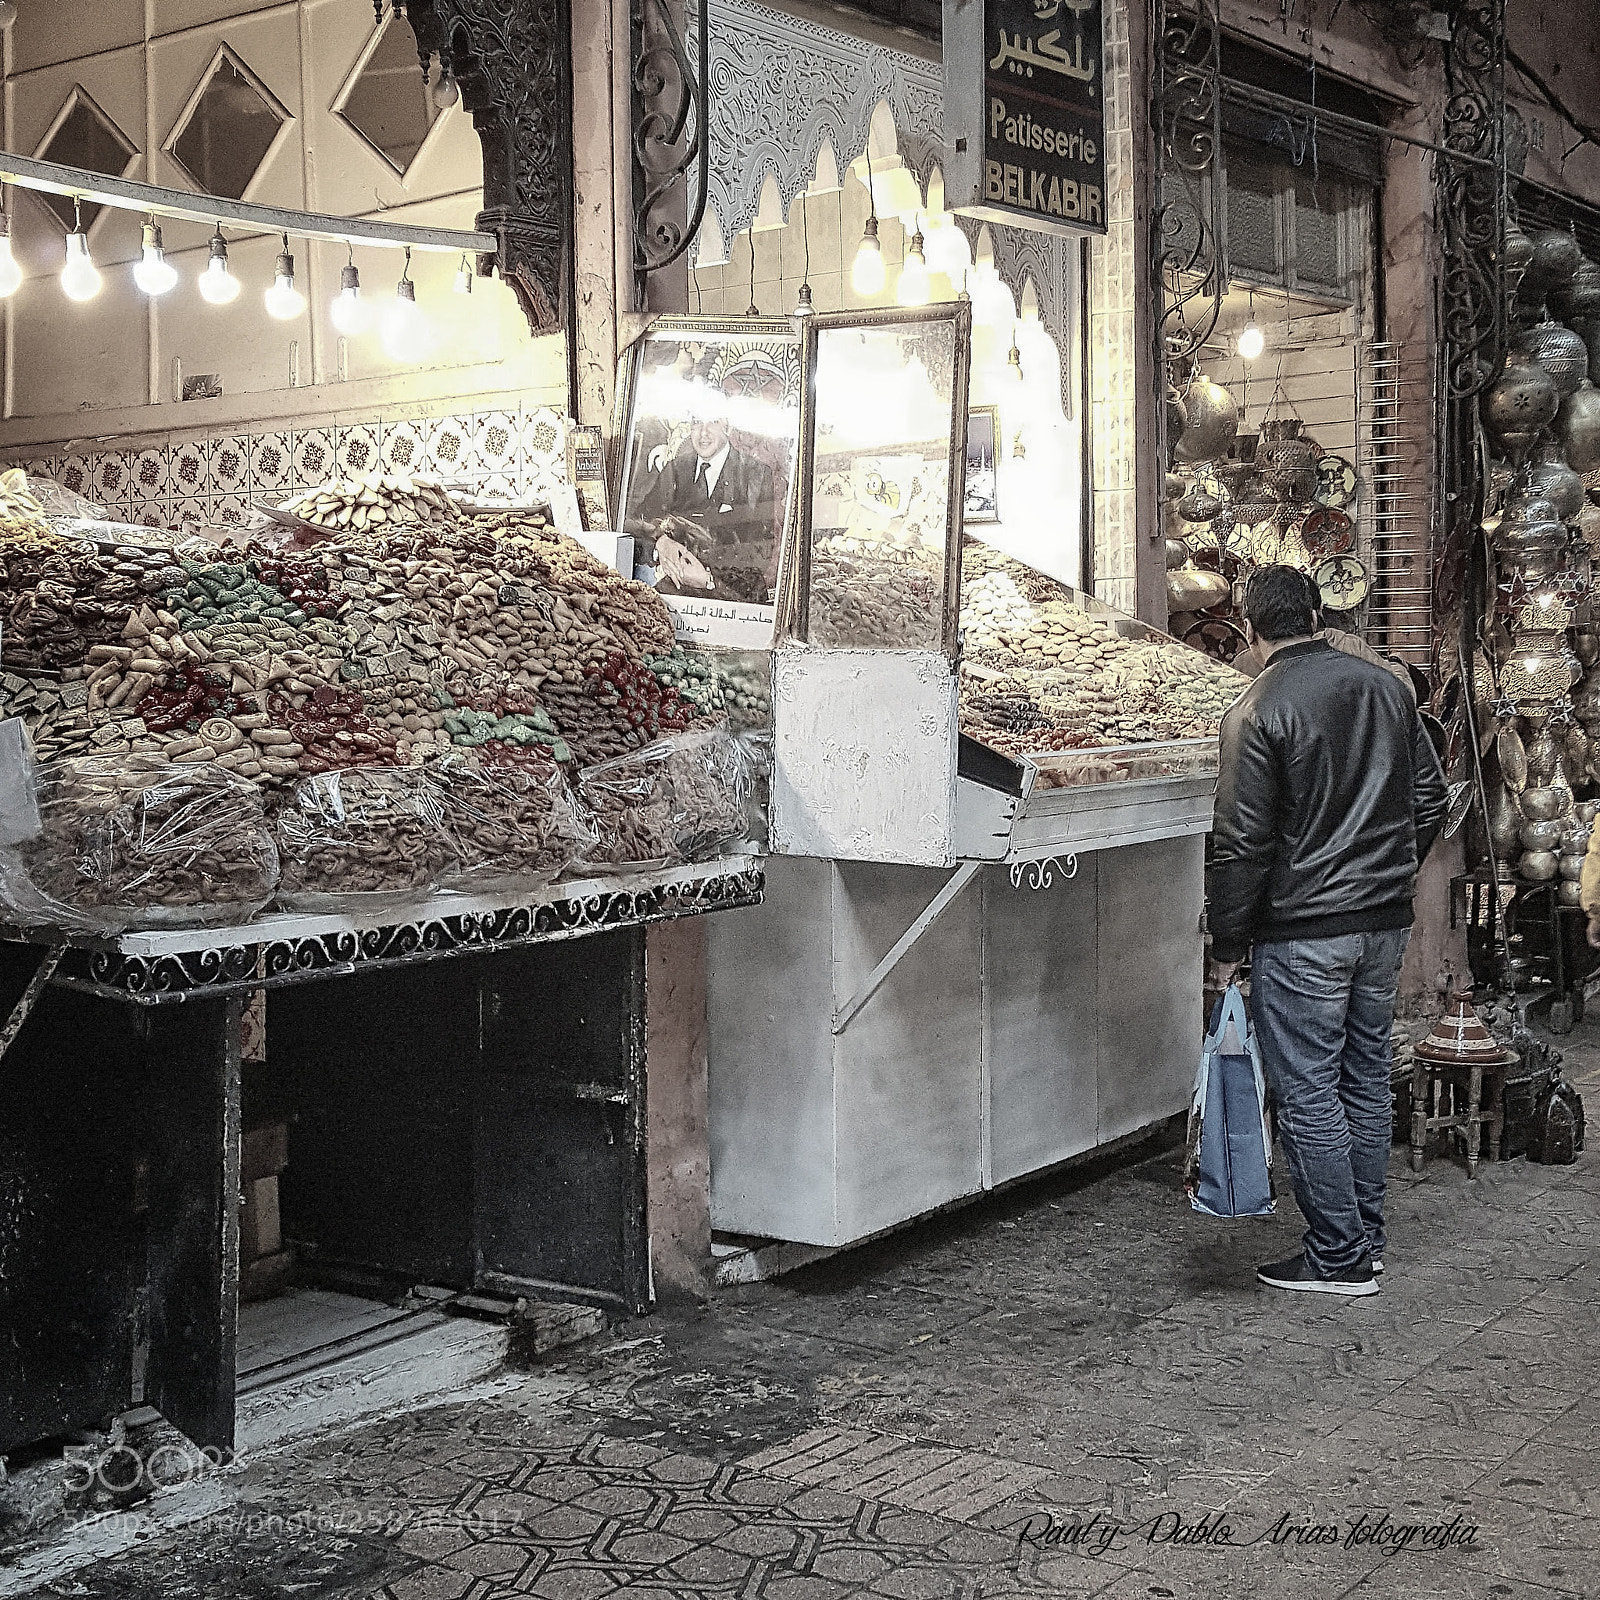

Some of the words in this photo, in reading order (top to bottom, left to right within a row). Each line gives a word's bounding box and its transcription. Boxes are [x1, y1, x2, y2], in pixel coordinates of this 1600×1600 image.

[989, 28, 1095, 97] بلكبير
[991, 97, 1098, 164] Patisserie
[985, 158, 1102, 223] BELKABIR
[680, 604, 707, 618] الملك
[709, 607, 737, 622] الجلالة
[738, 611, 773, 624] صاحب
